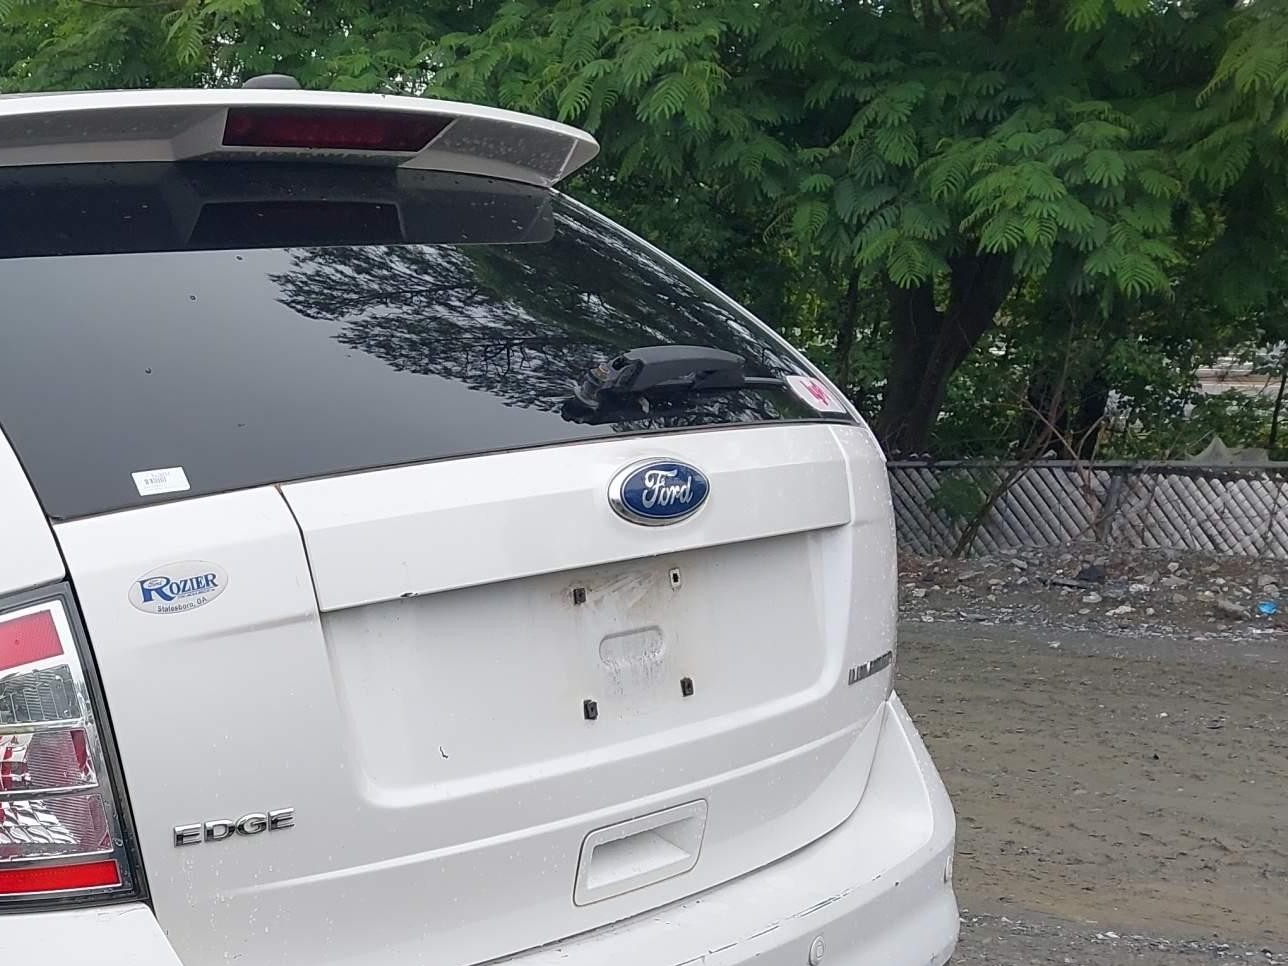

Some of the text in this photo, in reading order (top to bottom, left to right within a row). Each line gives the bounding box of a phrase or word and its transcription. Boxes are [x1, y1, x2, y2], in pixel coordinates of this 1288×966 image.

[642, 469, 694, 508] Ford
[136, 573, 219, 603] ROZIER
[173, 807, 295, 847] EDGE
